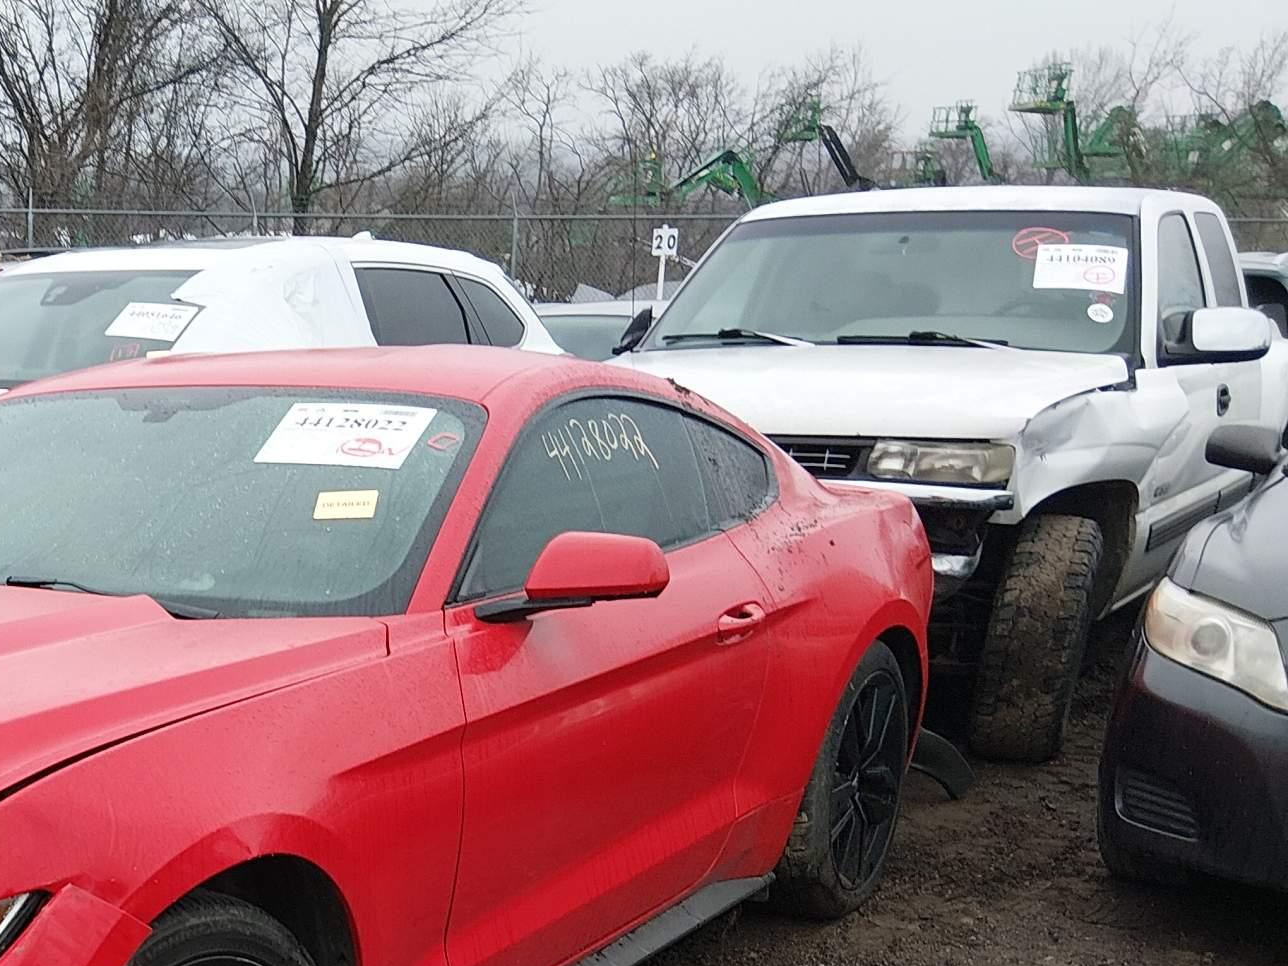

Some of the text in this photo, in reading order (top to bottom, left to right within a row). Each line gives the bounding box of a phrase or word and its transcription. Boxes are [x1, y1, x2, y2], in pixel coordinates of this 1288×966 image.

[654, 234, 677, 250] 20
[295, 415, 409, 431] 44128022
[541, 412, 660, 481] 44128022
